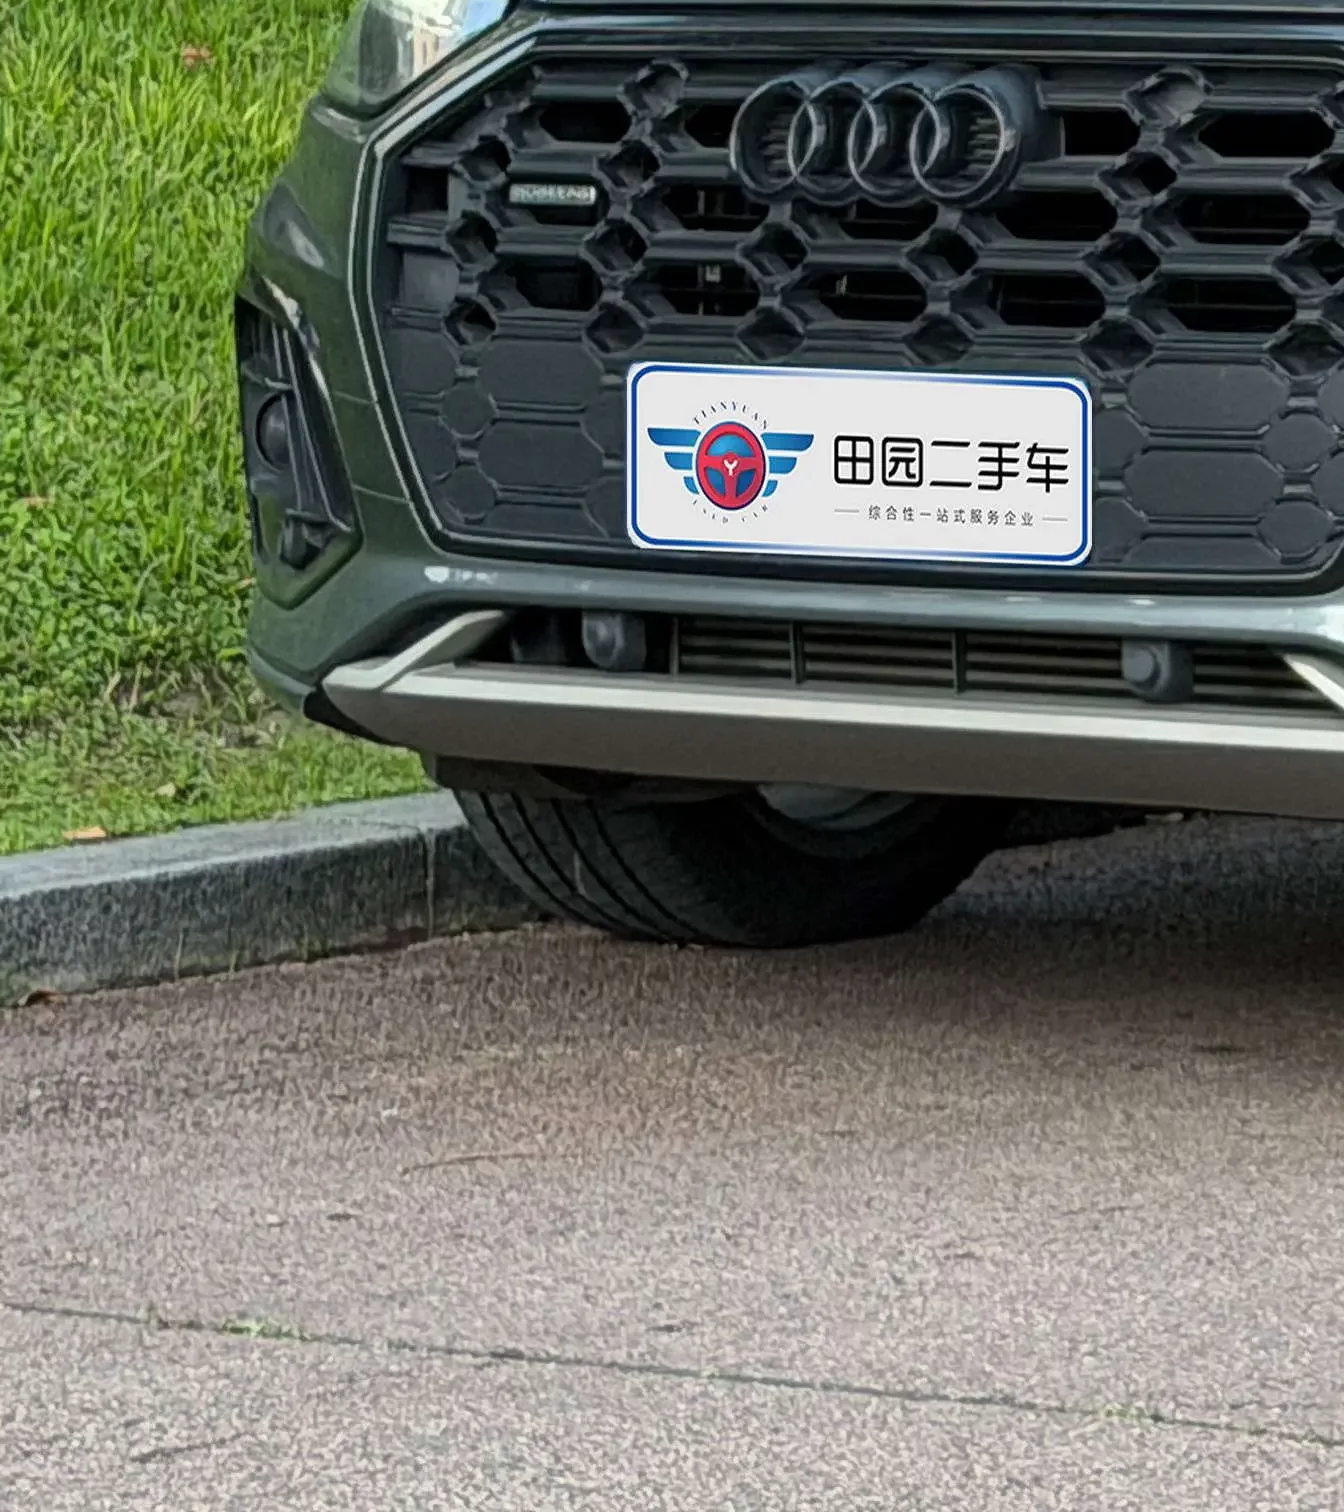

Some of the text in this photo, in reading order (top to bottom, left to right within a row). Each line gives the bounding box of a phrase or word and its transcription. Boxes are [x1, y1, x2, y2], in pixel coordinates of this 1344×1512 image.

[833, 435, 1070, 493] 田园二手车
[868, 504, 1034, 527] 综合性一站式服务企业
